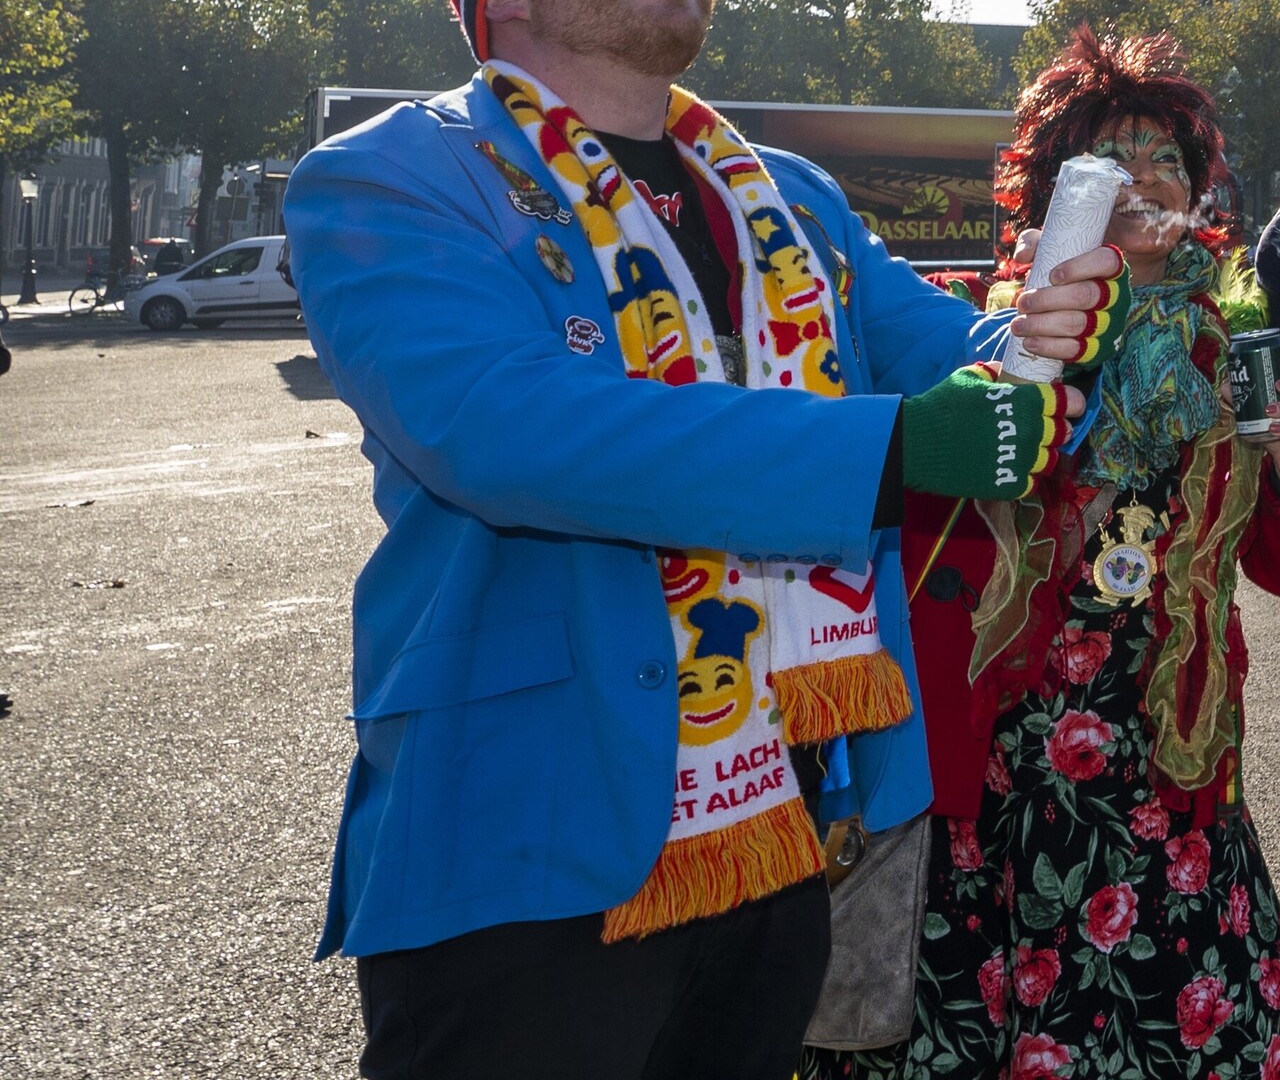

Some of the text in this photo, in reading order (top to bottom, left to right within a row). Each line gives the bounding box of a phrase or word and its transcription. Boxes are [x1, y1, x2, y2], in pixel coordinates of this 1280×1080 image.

[675, 738, 780, 793] E LACH
[706, 766, 784, 814] ALAAF
